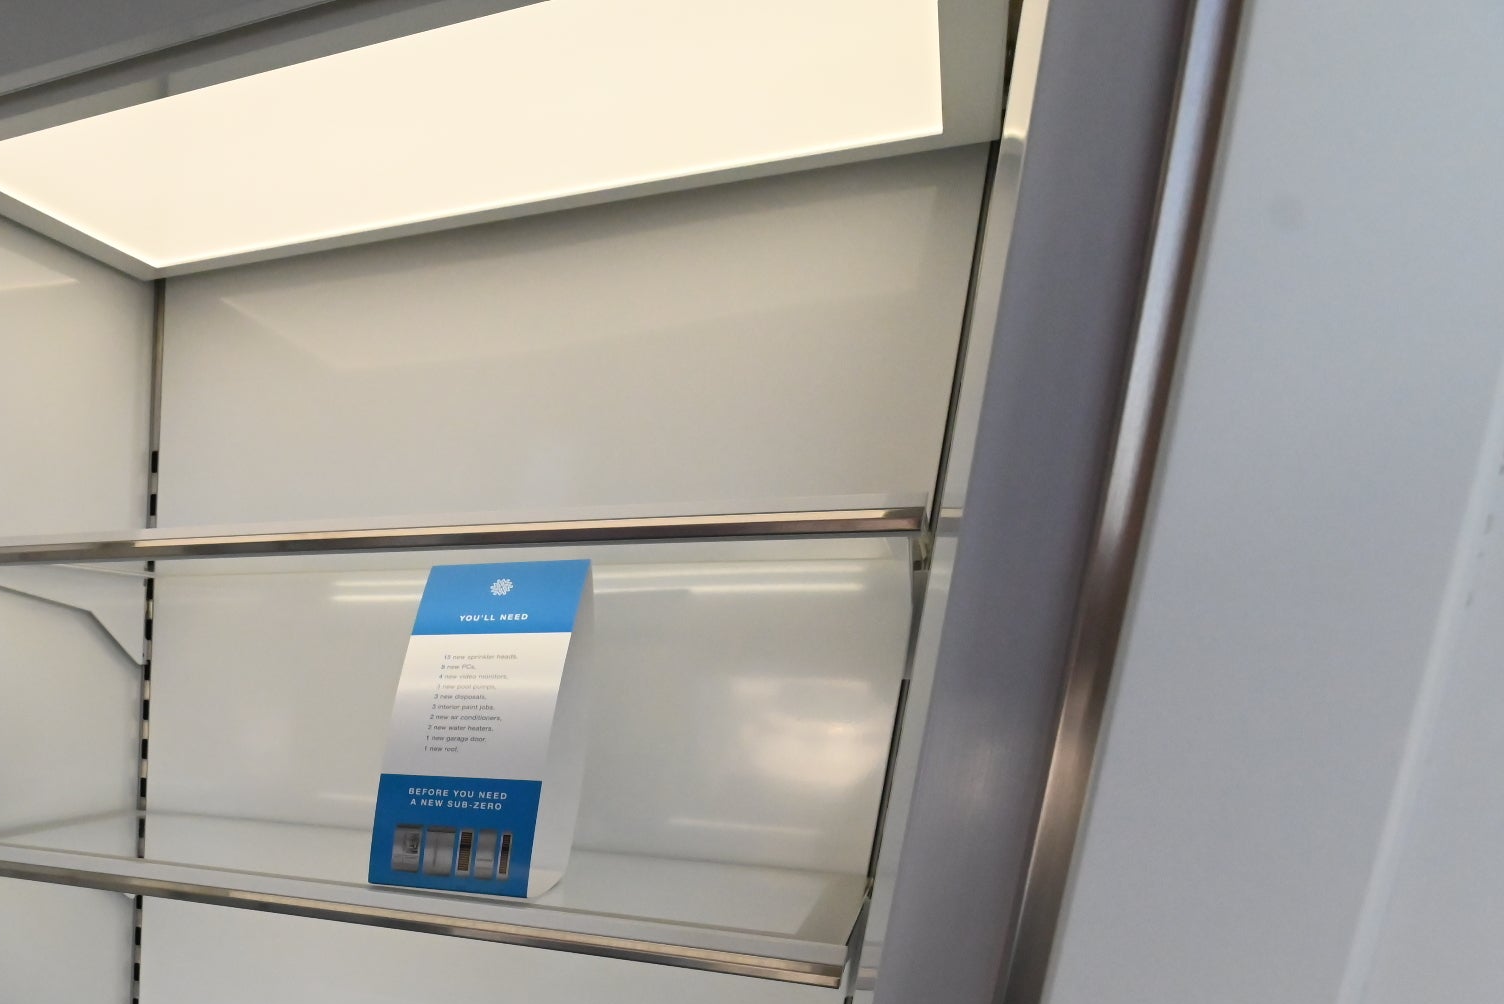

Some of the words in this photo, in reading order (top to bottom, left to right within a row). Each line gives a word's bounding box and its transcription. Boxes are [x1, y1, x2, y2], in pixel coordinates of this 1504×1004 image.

[459, 614, 496, 622] YOU'LL
[499, 613, 529, 621] NEED
[408, 787, 449, 797] BEFORE
[453, 789, 475, 799] YOU
[478, 791, 508, 800] NEED
[420, 799, 443, 808] NEW
[447, 800, 503, 811] SUB-ZERO
